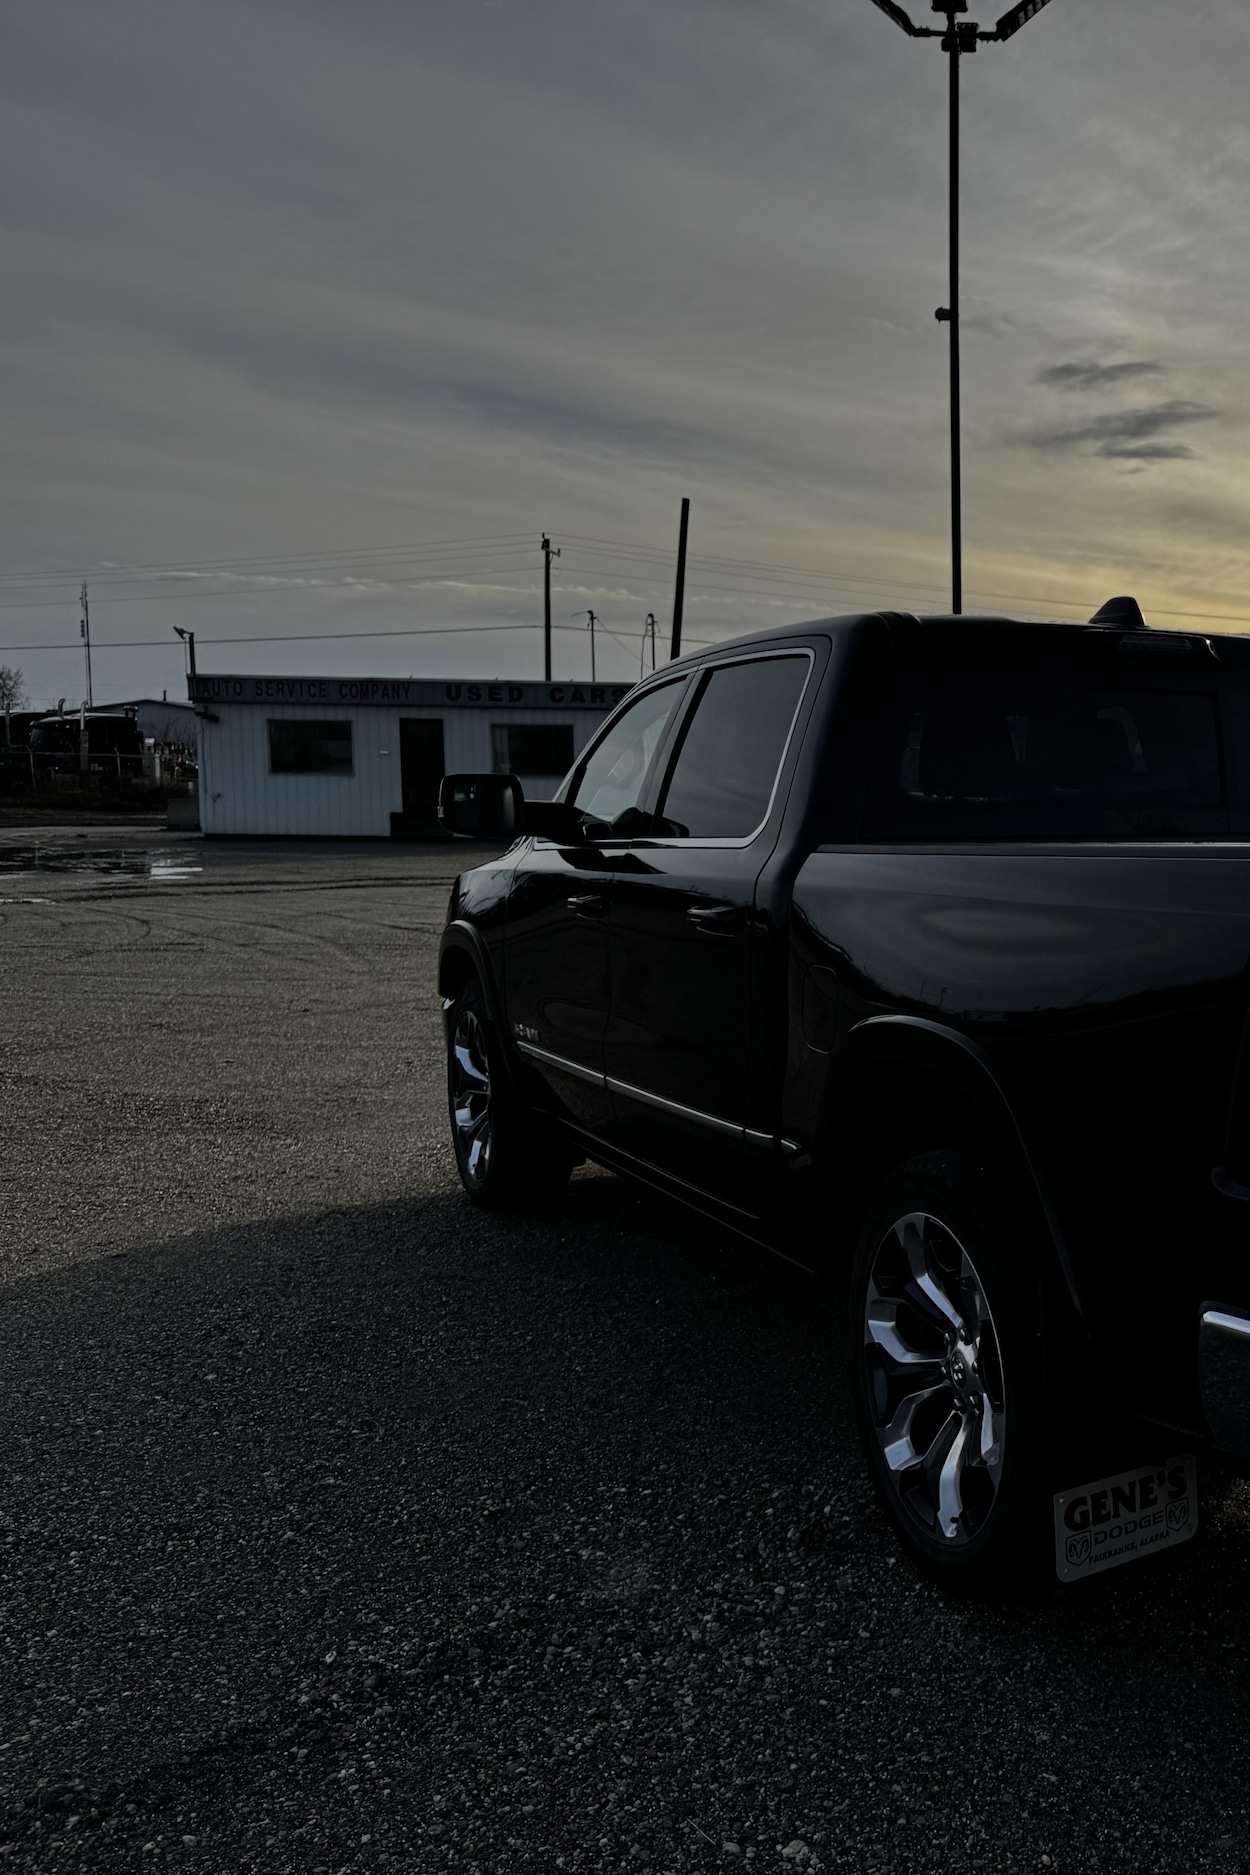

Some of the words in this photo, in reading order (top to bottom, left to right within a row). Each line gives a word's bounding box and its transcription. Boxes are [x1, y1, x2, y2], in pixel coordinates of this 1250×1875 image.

[202, 679, 243, 697] AUTO
[255, 680, 328, 698] SERVICE
[339, 682, 412, 701] COMPANY
[445, 684, 524, 702] USED
[549, 687, 627, 704] CARS
[1064, 1464, 1188, 1532] GENE'S
[1094, 1510, 1164, 1546] DODGE
[1088, 1541, 1138, 1565] FAIRBANKS,
[1140, 1530, 1170, 1547] ALASKA
